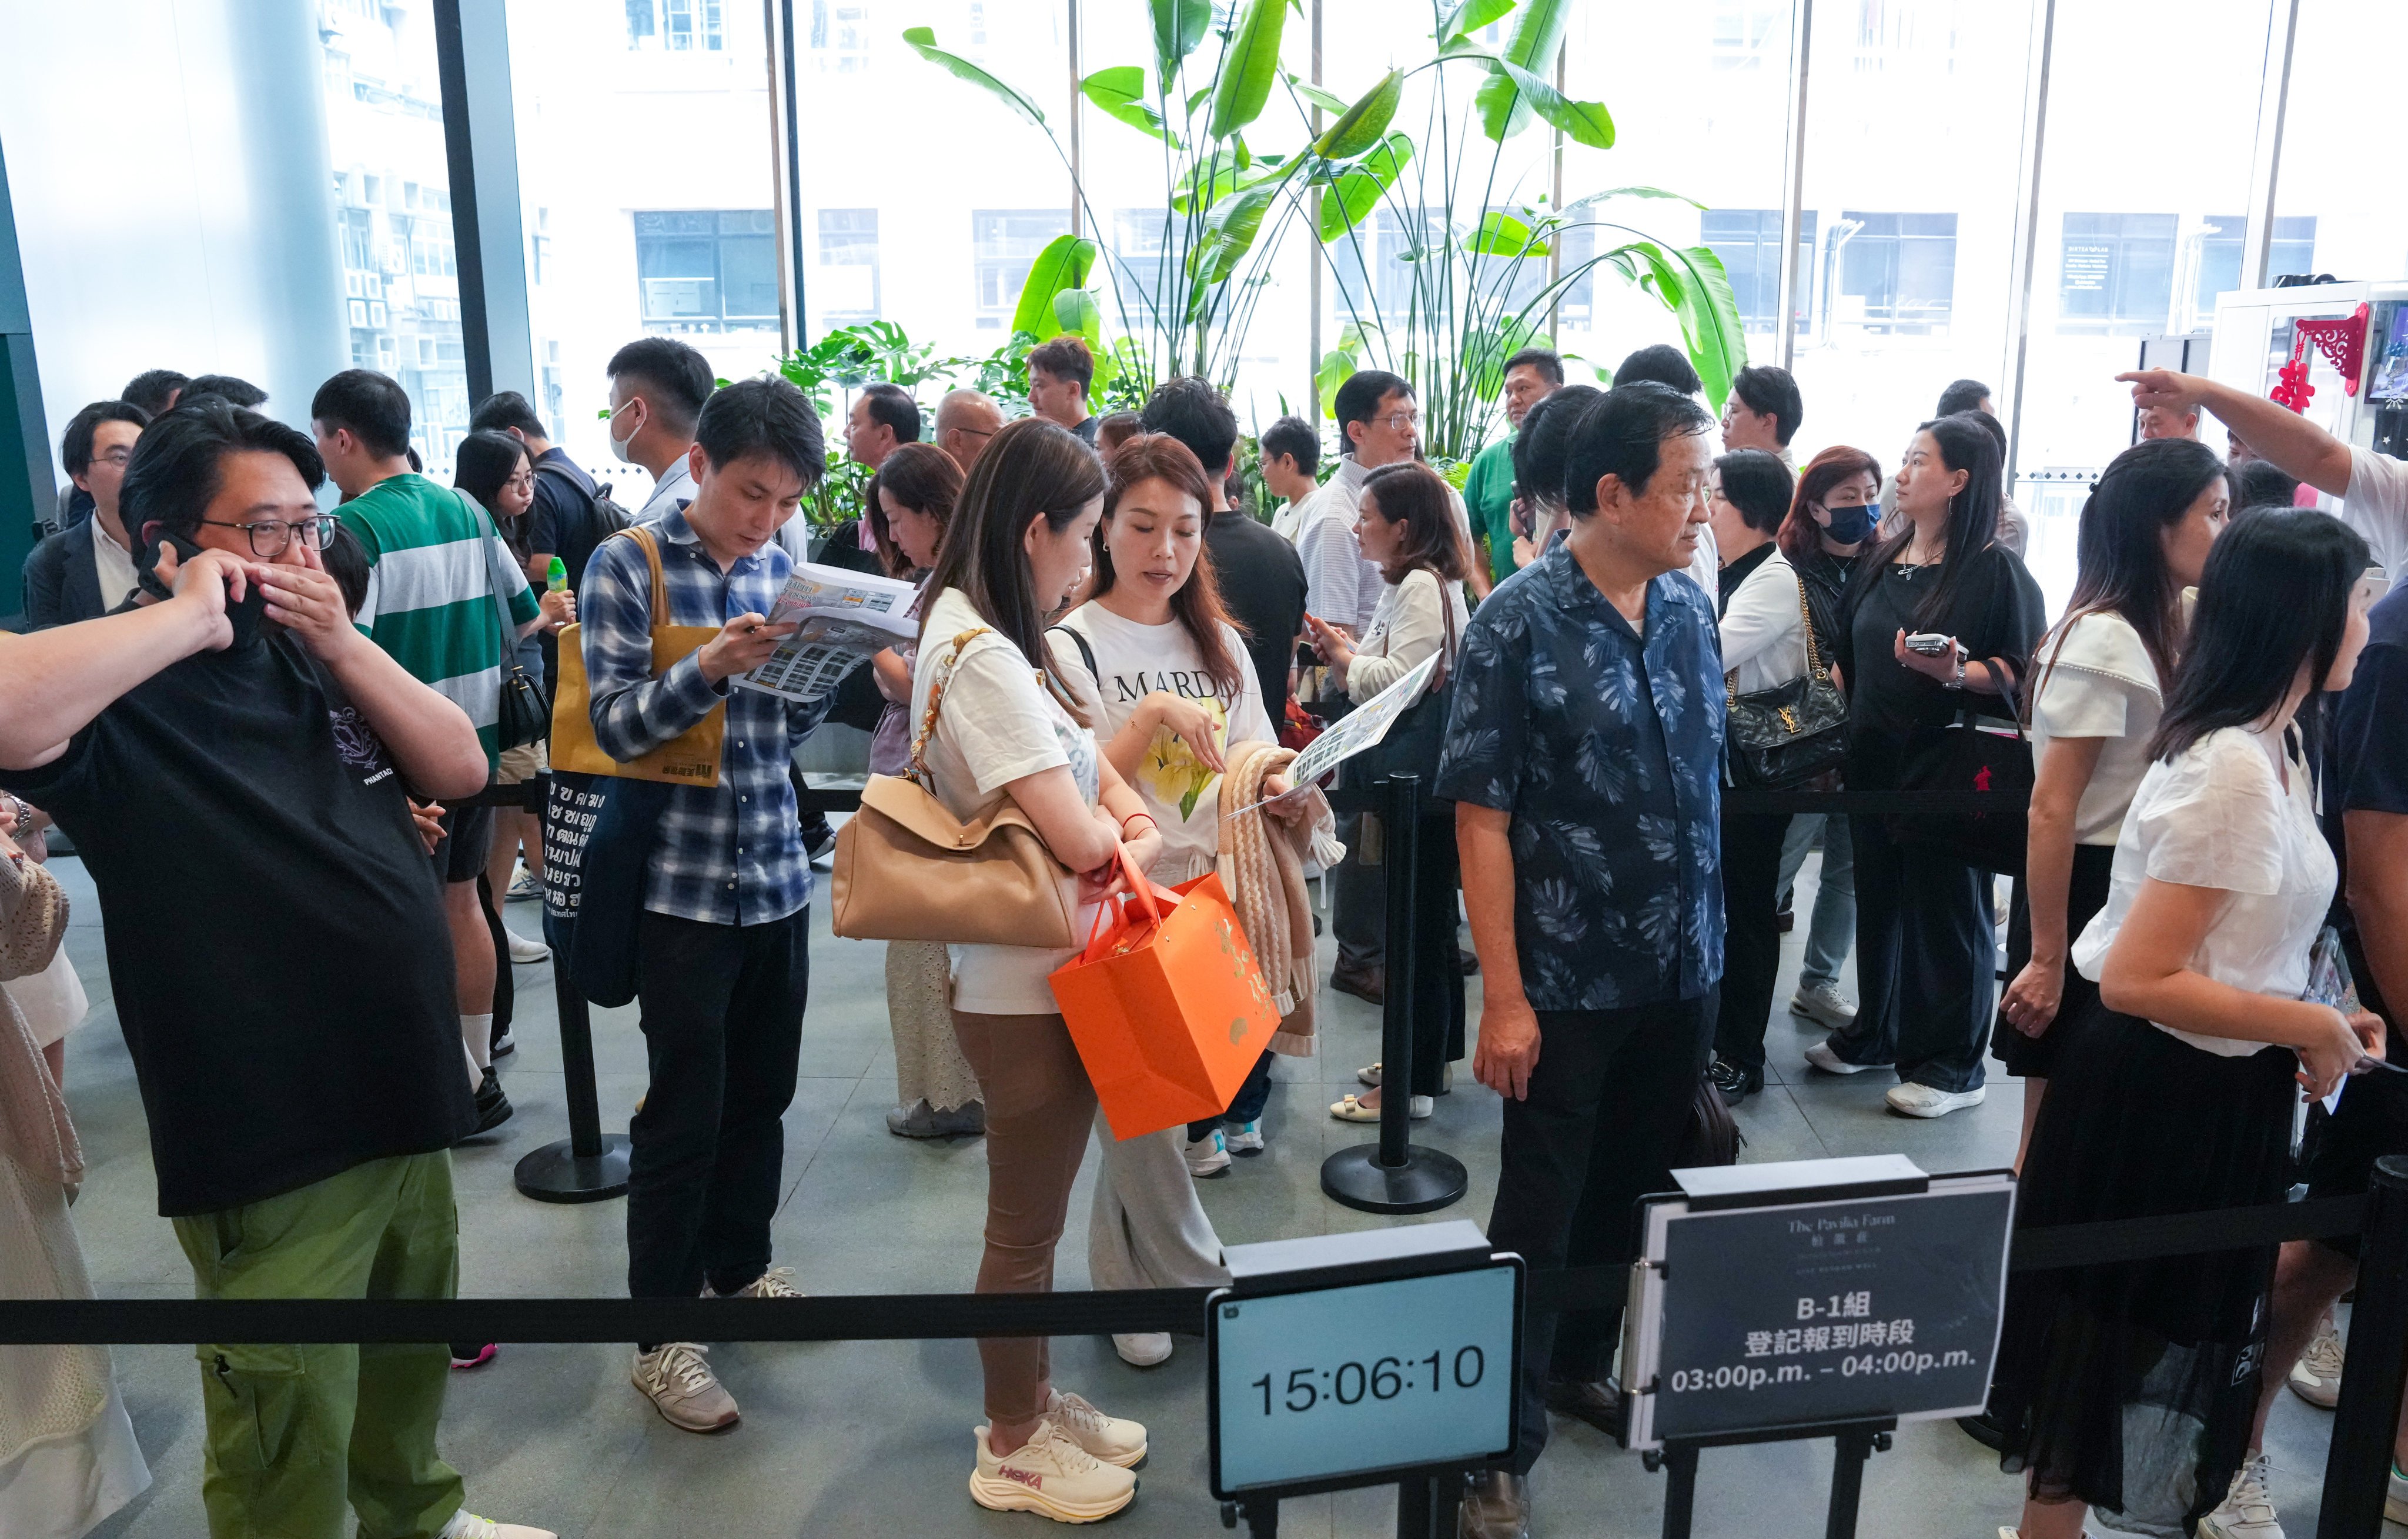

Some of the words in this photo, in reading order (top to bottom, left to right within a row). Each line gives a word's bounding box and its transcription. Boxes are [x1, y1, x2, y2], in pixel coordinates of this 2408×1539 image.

[1788, 1219, 1814, 1233] The
[1797, 1291, 1871, 1320] B-1組
[1744, 1318, 1915, 1358] 登記報到時段
[1252, 1344, 1484, 1416] 15:06:10
[1671, 1363, 1811, 1393] 03:00p.m.
[1841, 1349, 1976, 1377] 04:00p.m.
[998, 1464, 1042, 1490] HOKA
